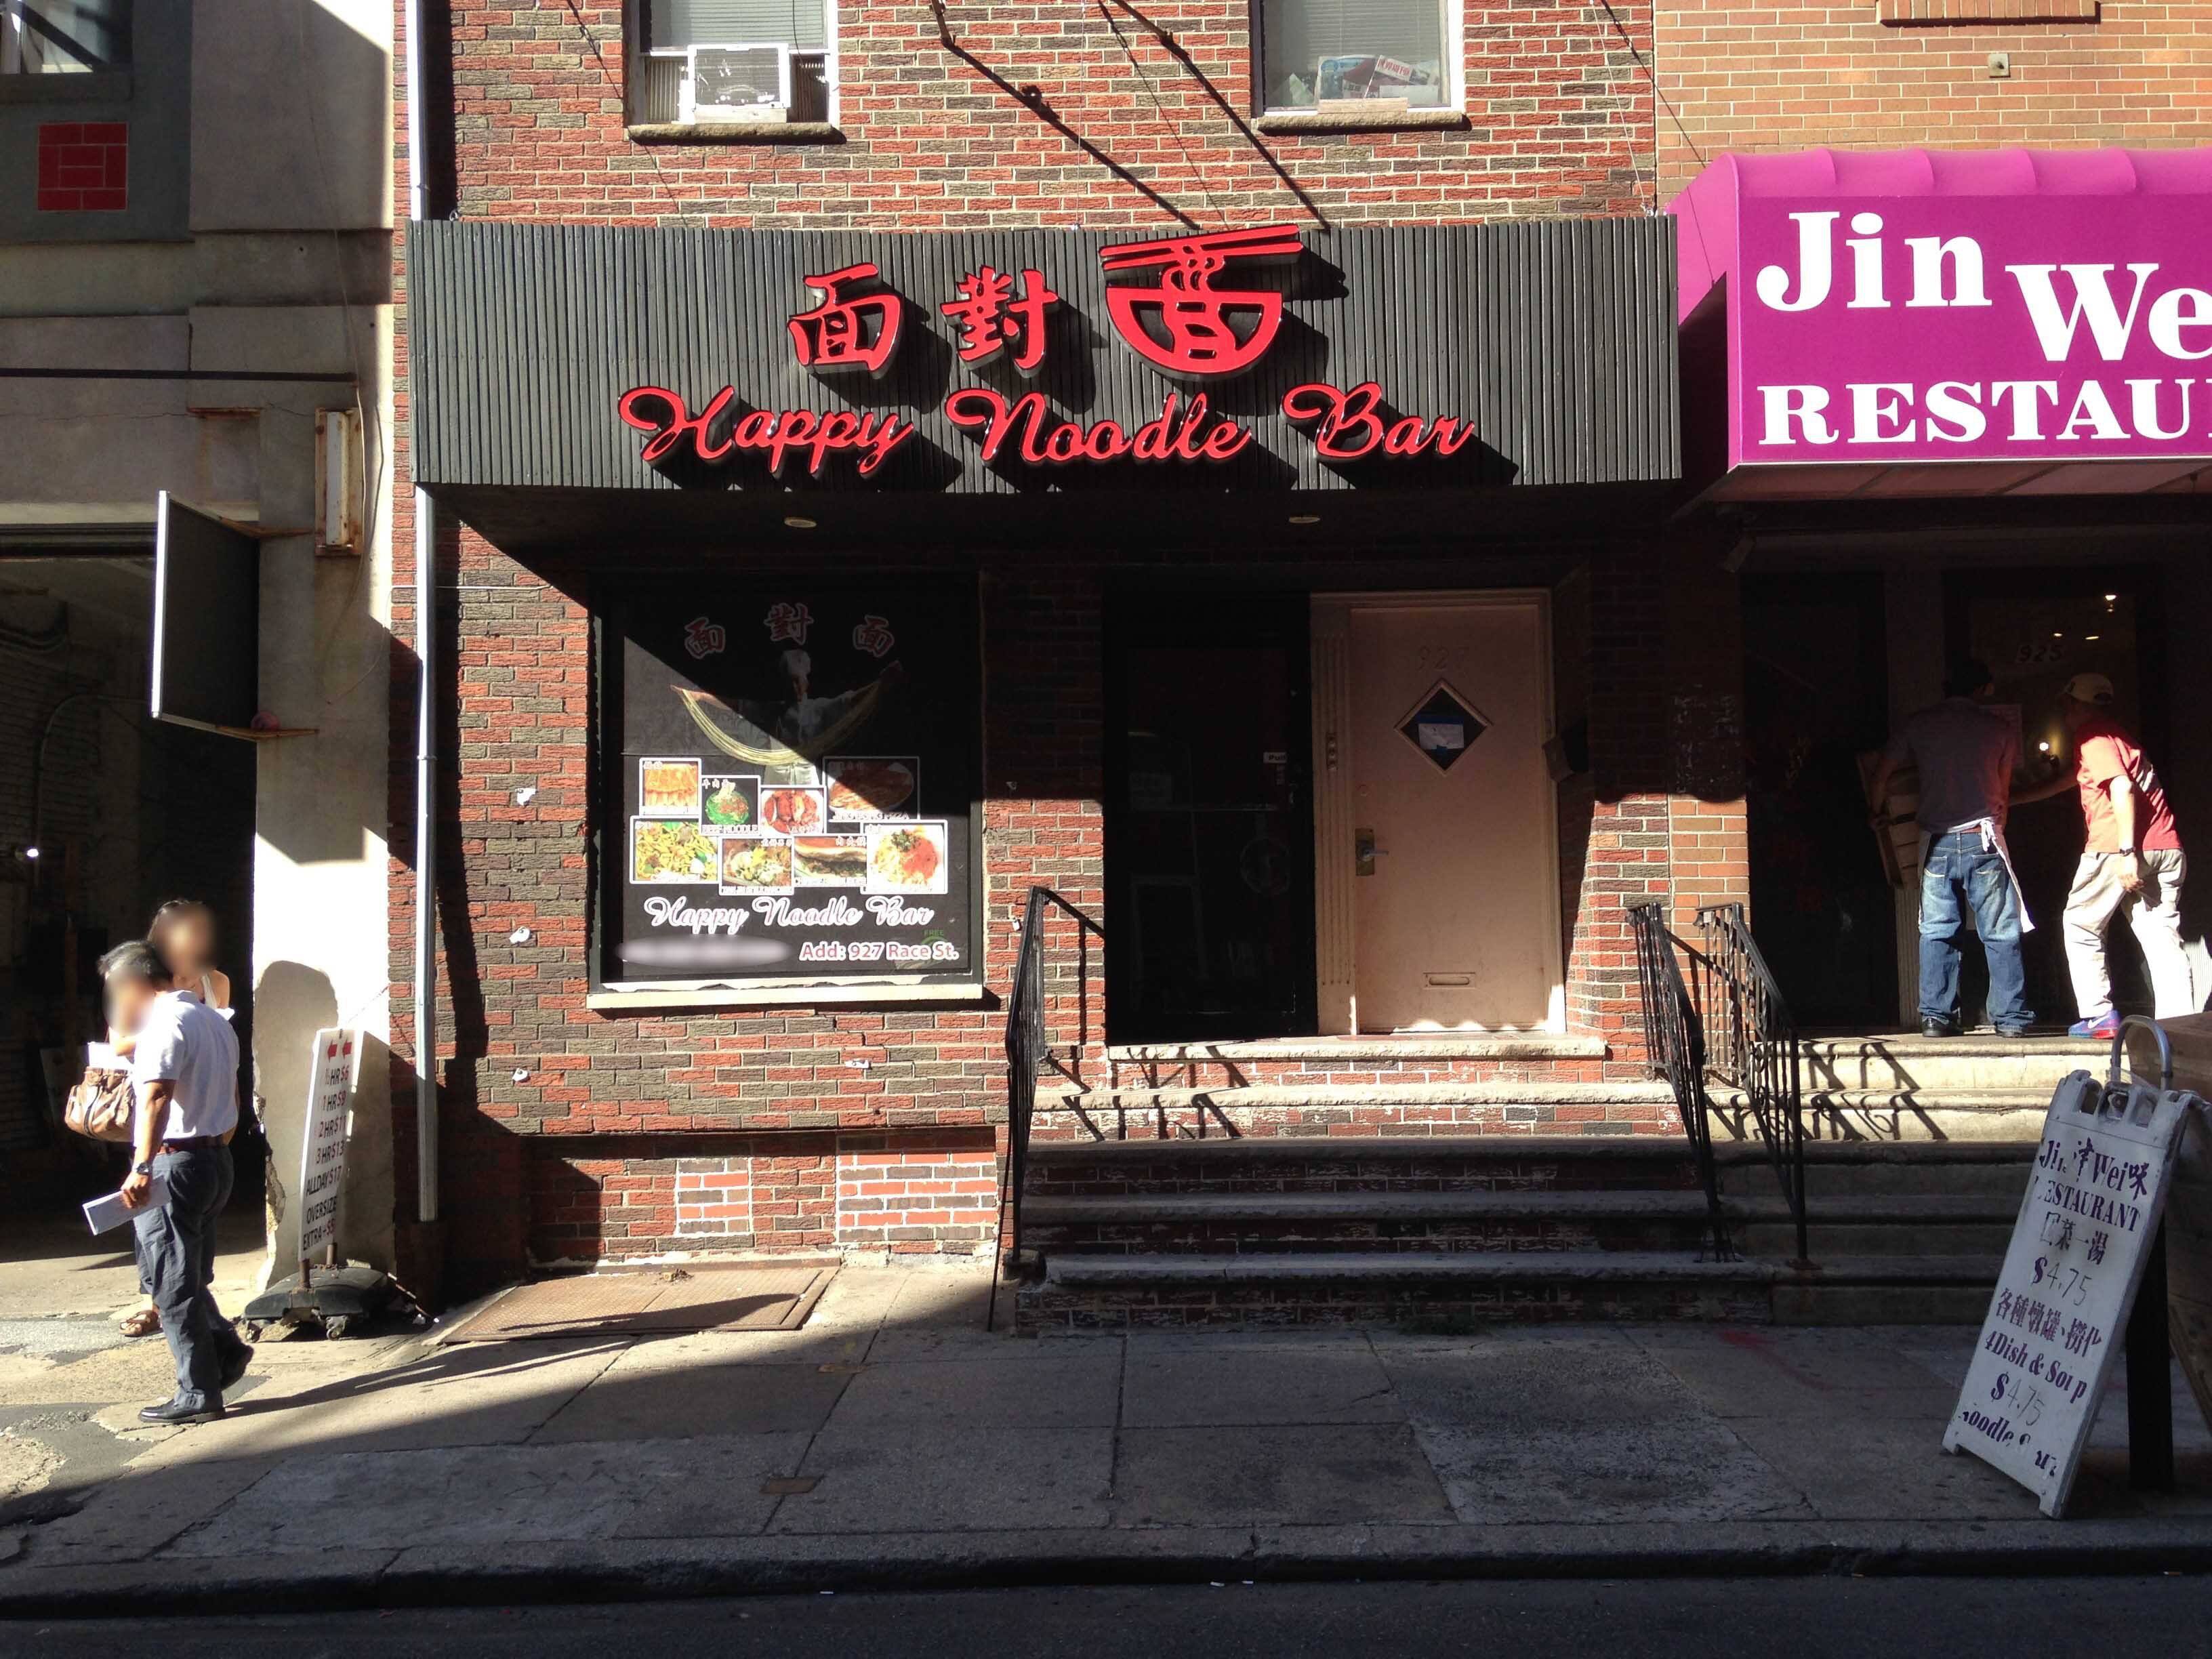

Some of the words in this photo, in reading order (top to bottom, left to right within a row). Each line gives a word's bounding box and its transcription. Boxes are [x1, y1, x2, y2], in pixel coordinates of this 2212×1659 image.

[1756, 211, 1992, 312] Jin
[618, 385, 915, 476] Happy
[945, 388, 1252, 465] Noodle
[1279, 380, 1477, 462] Bar
[1757, 378, 2212, 446] RESTAU
[644, 895, 750, 935] Happy
[752, 895, 863, 927] Noodle
[865, 895, 935, 926] Bar
[799, 941, 846, 962] Add:
[848, 942, 884, 961] 927
[886, 941, 930, 961] Race
[933, 941, 960, 961] St.
[2092, 1153, 2129, 1191] Wei
[2034, 1175, 2142, 1232] ESTAURANT
[2028, 1353, 2044, 1376] &
